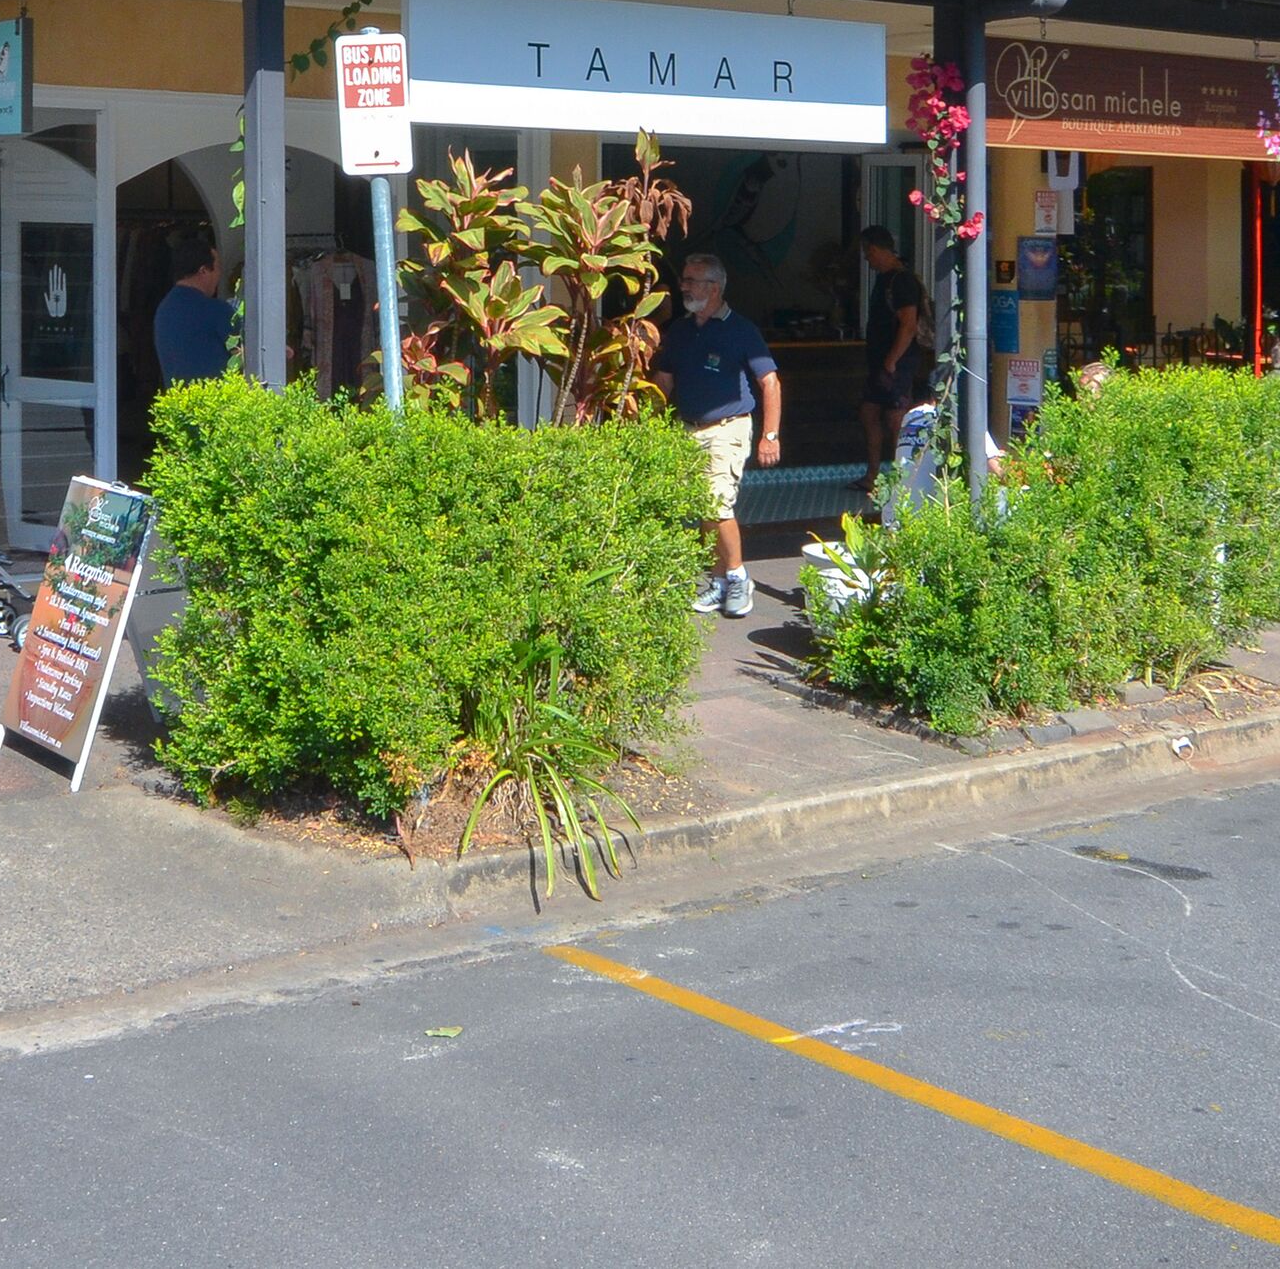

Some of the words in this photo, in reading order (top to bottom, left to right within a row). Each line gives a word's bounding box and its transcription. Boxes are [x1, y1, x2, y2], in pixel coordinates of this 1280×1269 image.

[343, 45, 369, 65] BUS
[374, 44, 401, 64] AND
[344, 66, 402, 86] LOADING
[527, 41, 794, 95] TAMAR
[357, 87, 392, 107] ZONE
[1010, 59, 1056, 109] villa
[1060, 91, 1096, 112] san
[1106, 66, 1182, 118] michele
[1061, 118, 1114, 135] BOUTIQUE
[1116, 122, 1182, 137] APARTMENTS
[992, 295, 1017, 309] OGA
[70, 555, 114, 586] Reception
